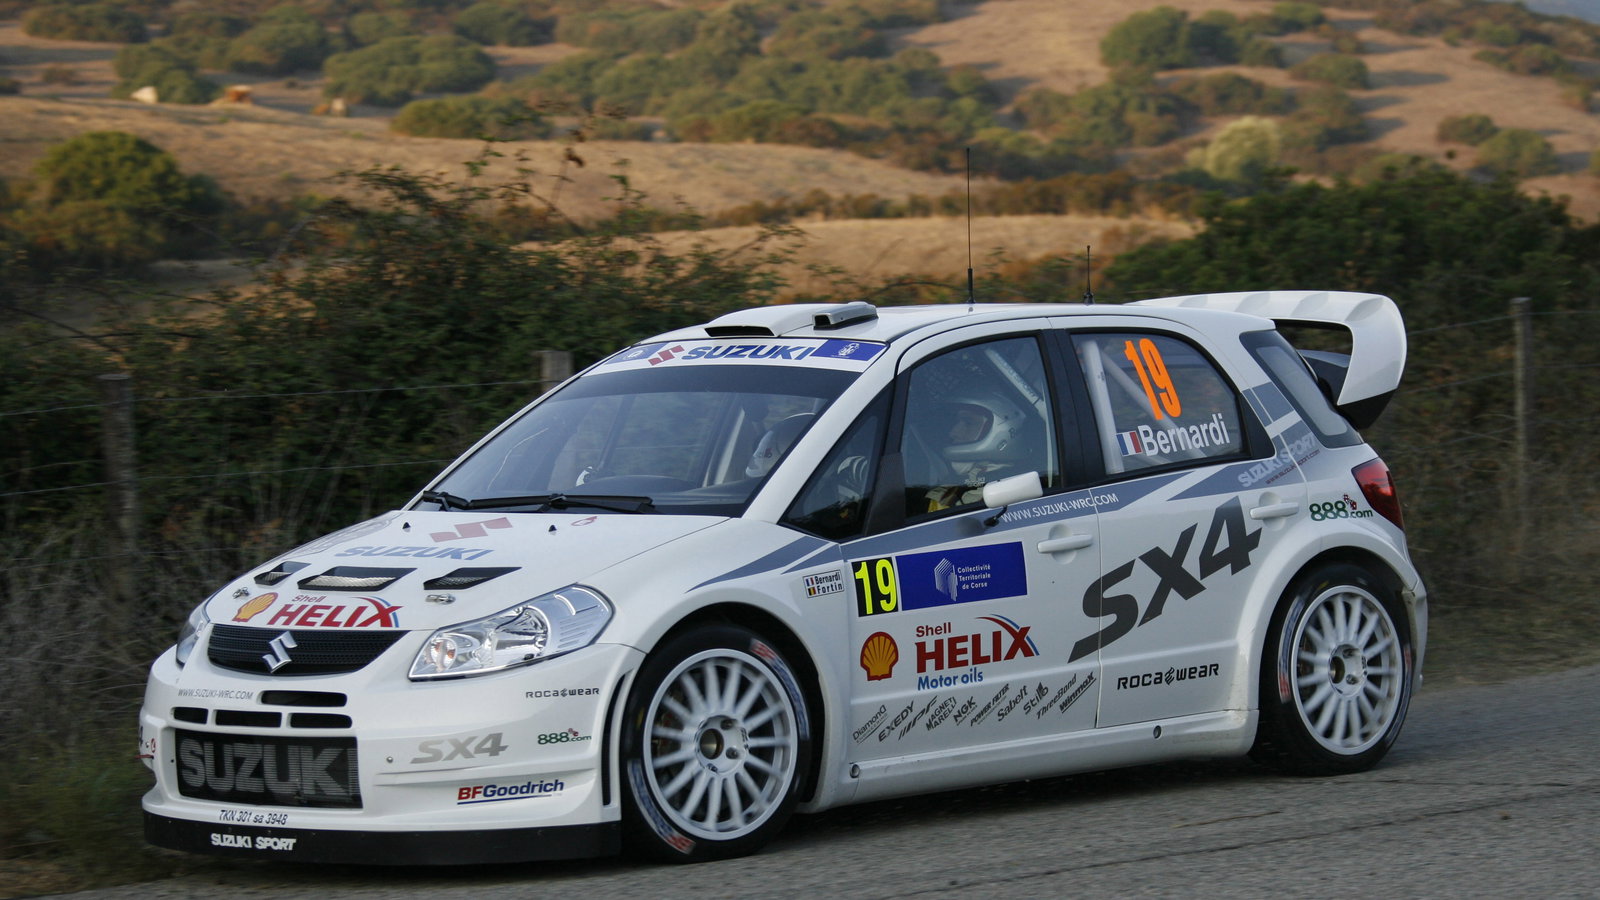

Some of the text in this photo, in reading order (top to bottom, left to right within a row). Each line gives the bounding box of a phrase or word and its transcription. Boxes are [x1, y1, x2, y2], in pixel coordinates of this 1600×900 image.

[681, 344, 816, 361] SUZUKI
[1124, 337, 1182, 421] 19
[1137, 412, 1230, 458] Bernardi
[1000, 493, 1119, 523] WWW.SUZUKI-WRC.COM
[1309, 500, 1374, 521] 888.com
[334, 545, 495, 561] SUZUKI
[815, 571, 841, 586] Bernardi
[957, 563, 991, 574] Collectivité
[958, 572, 991, 582] Territoriale
[1067, 495, 1263, 664] SX4
[291, 594, 327, 603] Shell
[816, 582, 843, 595] Fortin
[854, 558, 898, 615] 19
[267, 600, 404, 628] HELIX
[916, 621, 952, 638] Shell
[914, 622, 1036, 674] HELIX
[917, 667, 984, 691] Motor oils
[1059, 671, 1095, 711] Winmax
[953, 696, 976, 723] NGK
[997, 685, 1029, 722] Sabelt
[1023, 682, 1049, 715] Stilo
[1036, 673, 1077, 720] ThreeBond
[852, 704, 887, 741] Diamond
[878, 700, 914, 742] EXEDY
[970, 702, 992, 727] POWER
[410, 732, 509, 764] SX4
[537, 731, 592, 746] 888.com
[179, 738, 360, 797] SUZUKI
[457, 779, 565, 801] BFGoodrich
[219, 809, 288, 825] TKN 301 sa 3948
[211, 832, 297, 851] SUZUKI SPORT
